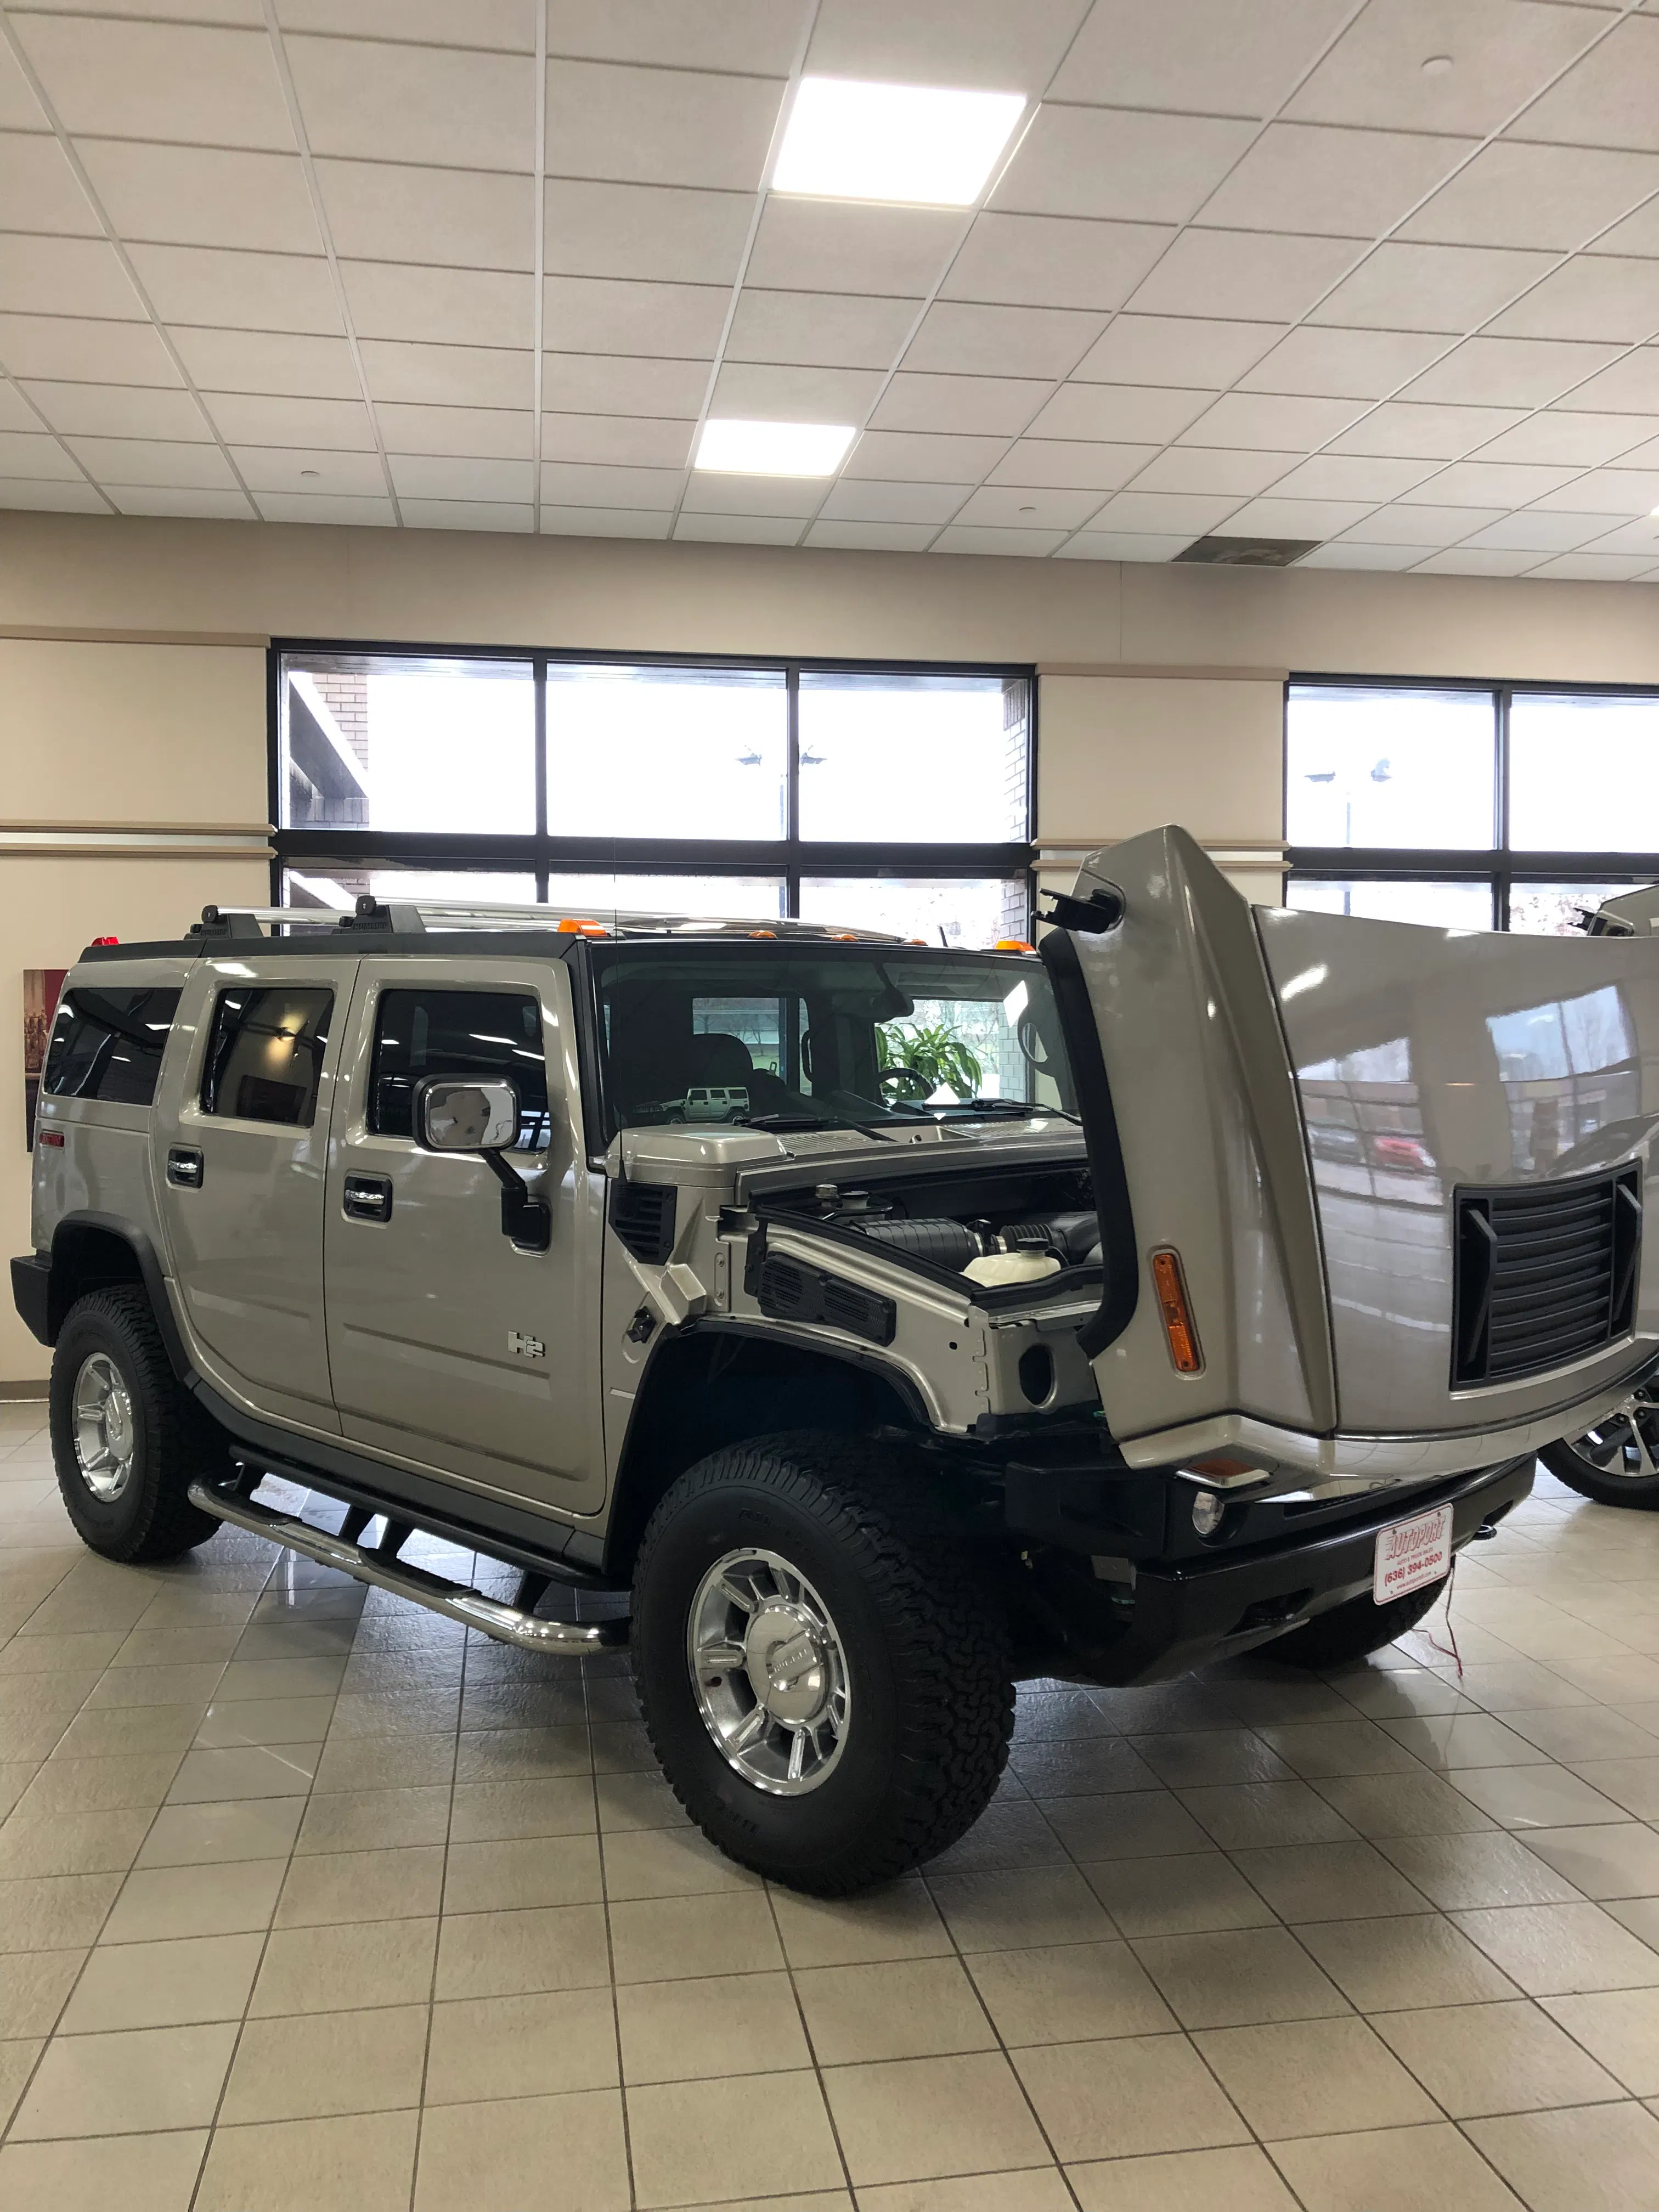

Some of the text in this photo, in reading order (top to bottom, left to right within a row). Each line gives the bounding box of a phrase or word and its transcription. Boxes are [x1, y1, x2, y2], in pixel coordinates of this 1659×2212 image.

[507, 1330, 545, 1358] H2
[1385, 1515, 1446, 1560] AUTOPORT
[1385, 1551, 1442, 1587] (636) 394-0500
